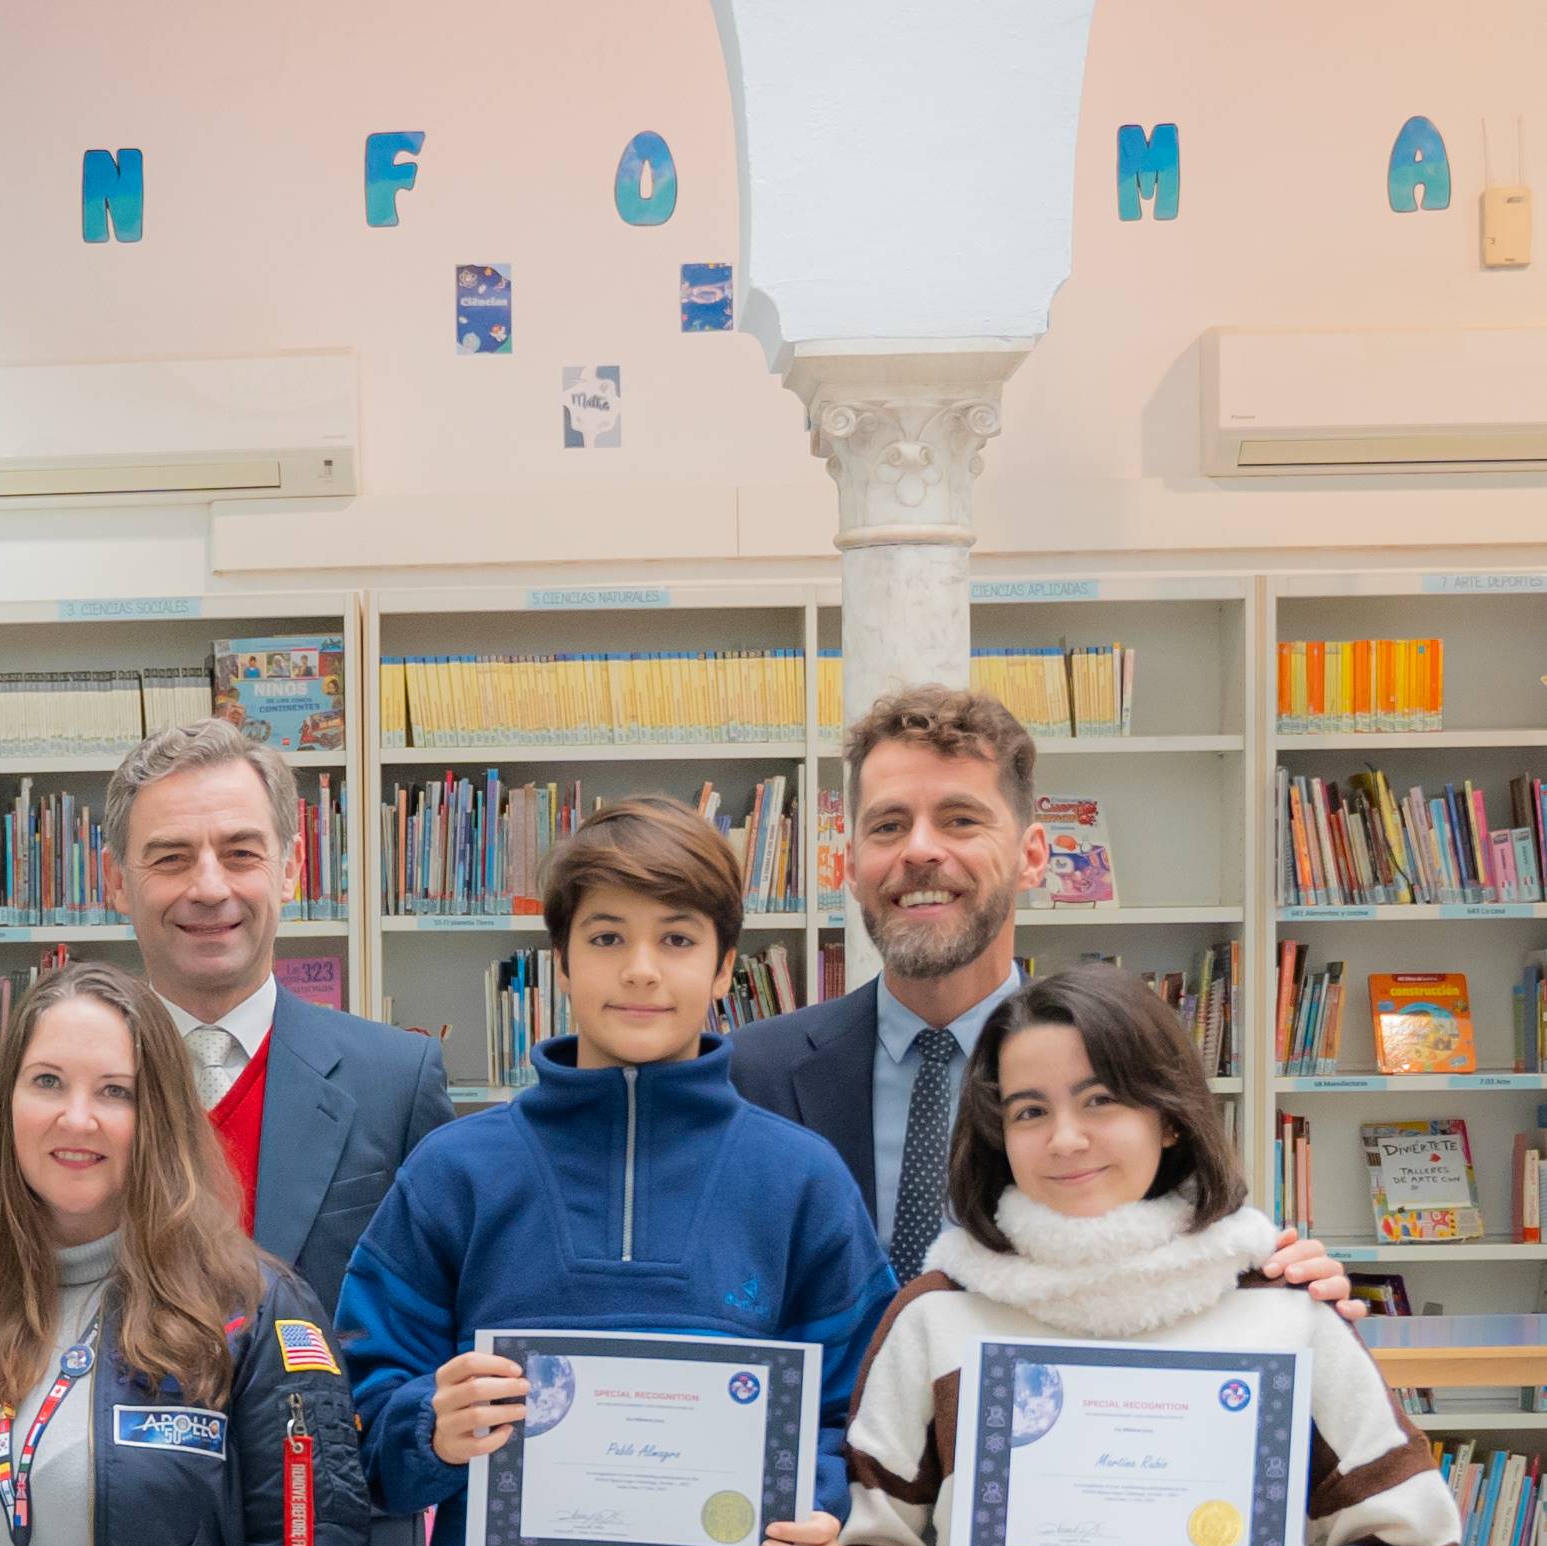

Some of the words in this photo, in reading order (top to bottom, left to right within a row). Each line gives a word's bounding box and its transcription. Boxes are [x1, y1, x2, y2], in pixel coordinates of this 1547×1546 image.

[542, 591, 596, 604] CIENCIAS
[598, 590, 660, 603] NATURALES
[971, 583, 1024, 598] CIENCIAS
[81, 601, 133, 616] CIENCIAS
[135, 600, 189, 614] SOCIALES
[302, 961, 333, 983] 323
[594, 1389, 631, 1399] SPECIAL
[634, 1391, 700, 1402] RECOGNITION
[1082, 1400, 1120, 1409] SPECIAL
[1122, 1401, 1190, 1411] RECOGNITION
[142, 1414, 220, 1439] APOLLO
[291, 1464, 307, 1502] REMOVE
[291, 1503, 308, 1540] BEFORE
